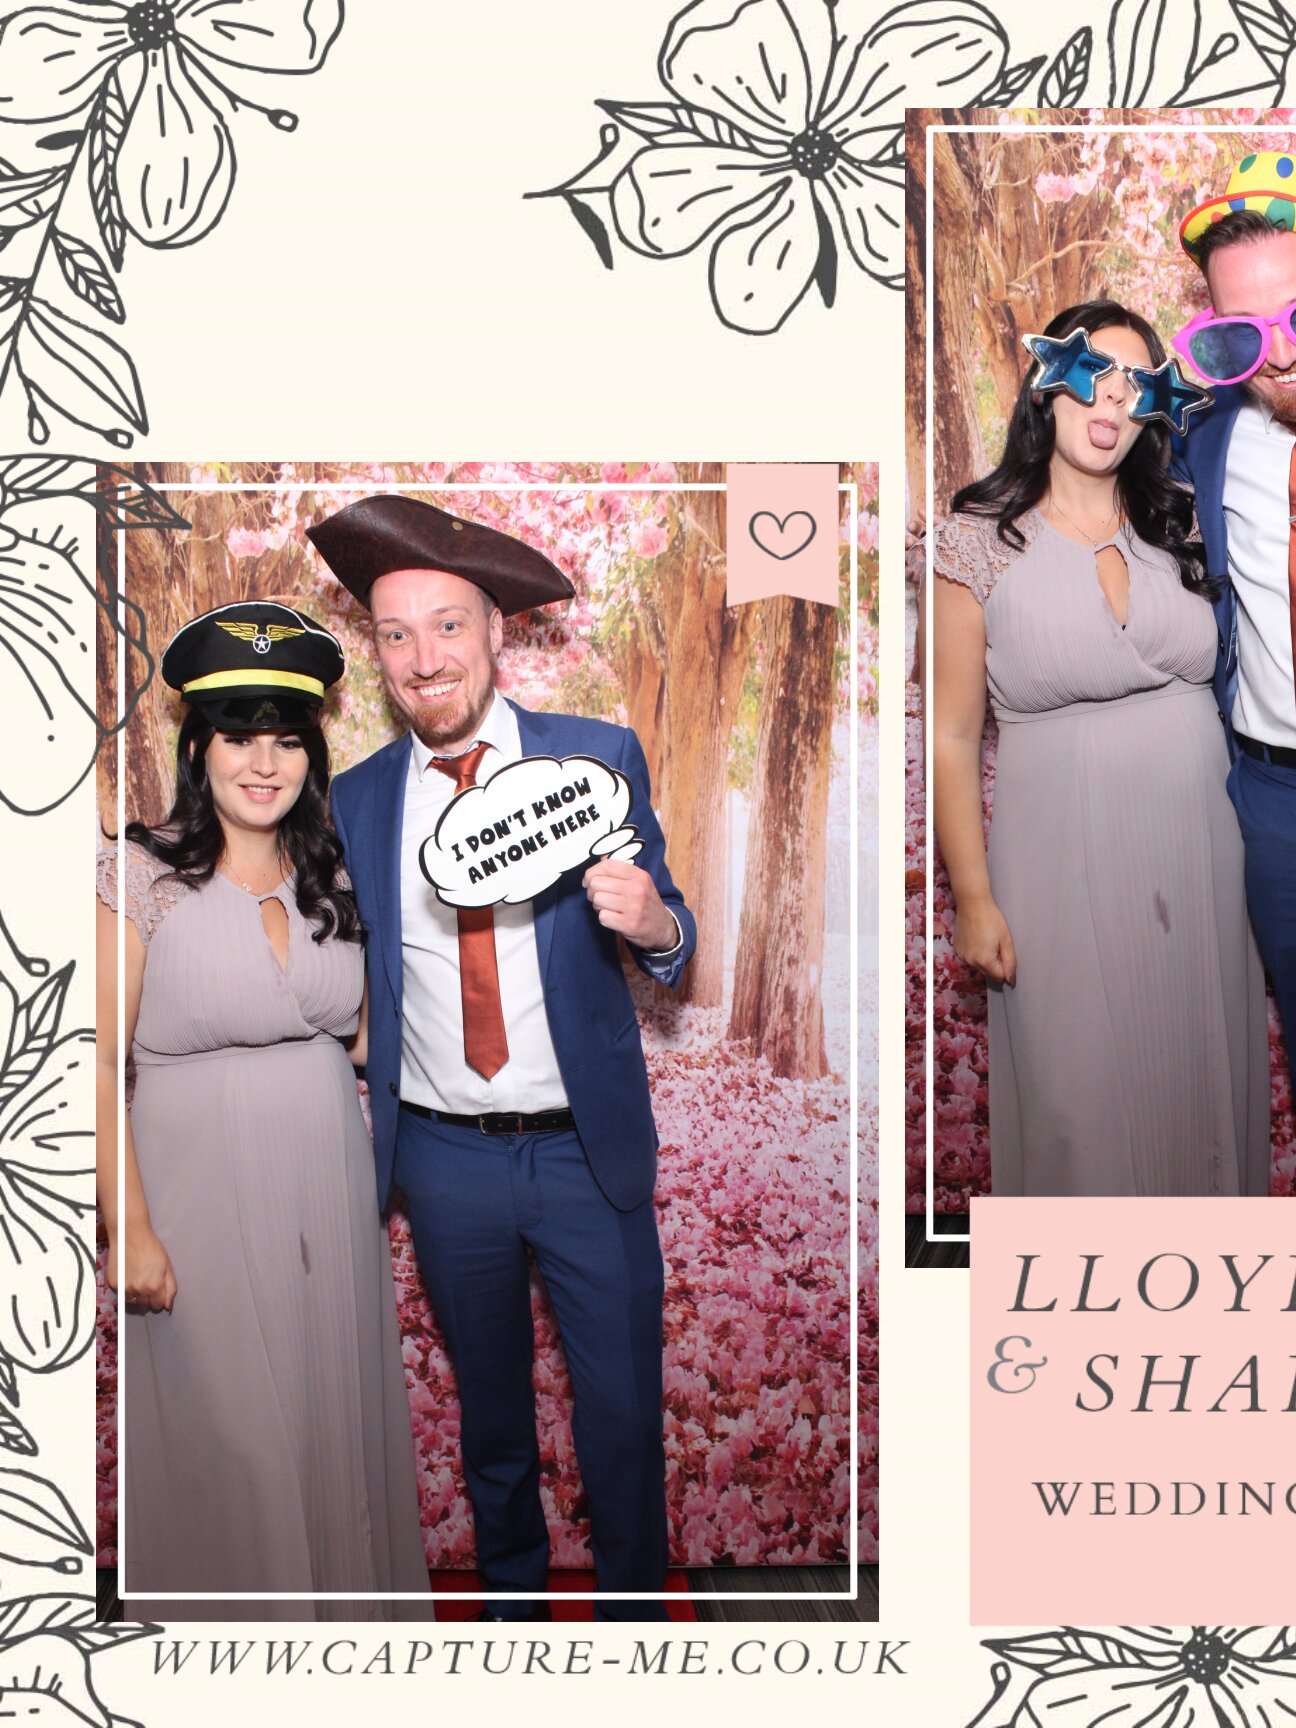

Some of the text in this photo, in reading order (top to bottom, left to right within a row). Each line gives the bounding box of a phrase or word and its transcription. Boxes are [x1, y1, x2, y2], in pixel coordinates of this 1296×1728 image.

[450, 777, 592, 863] I DON'T KNOW
[468, 804, 601, 884] ANYONE HERE
